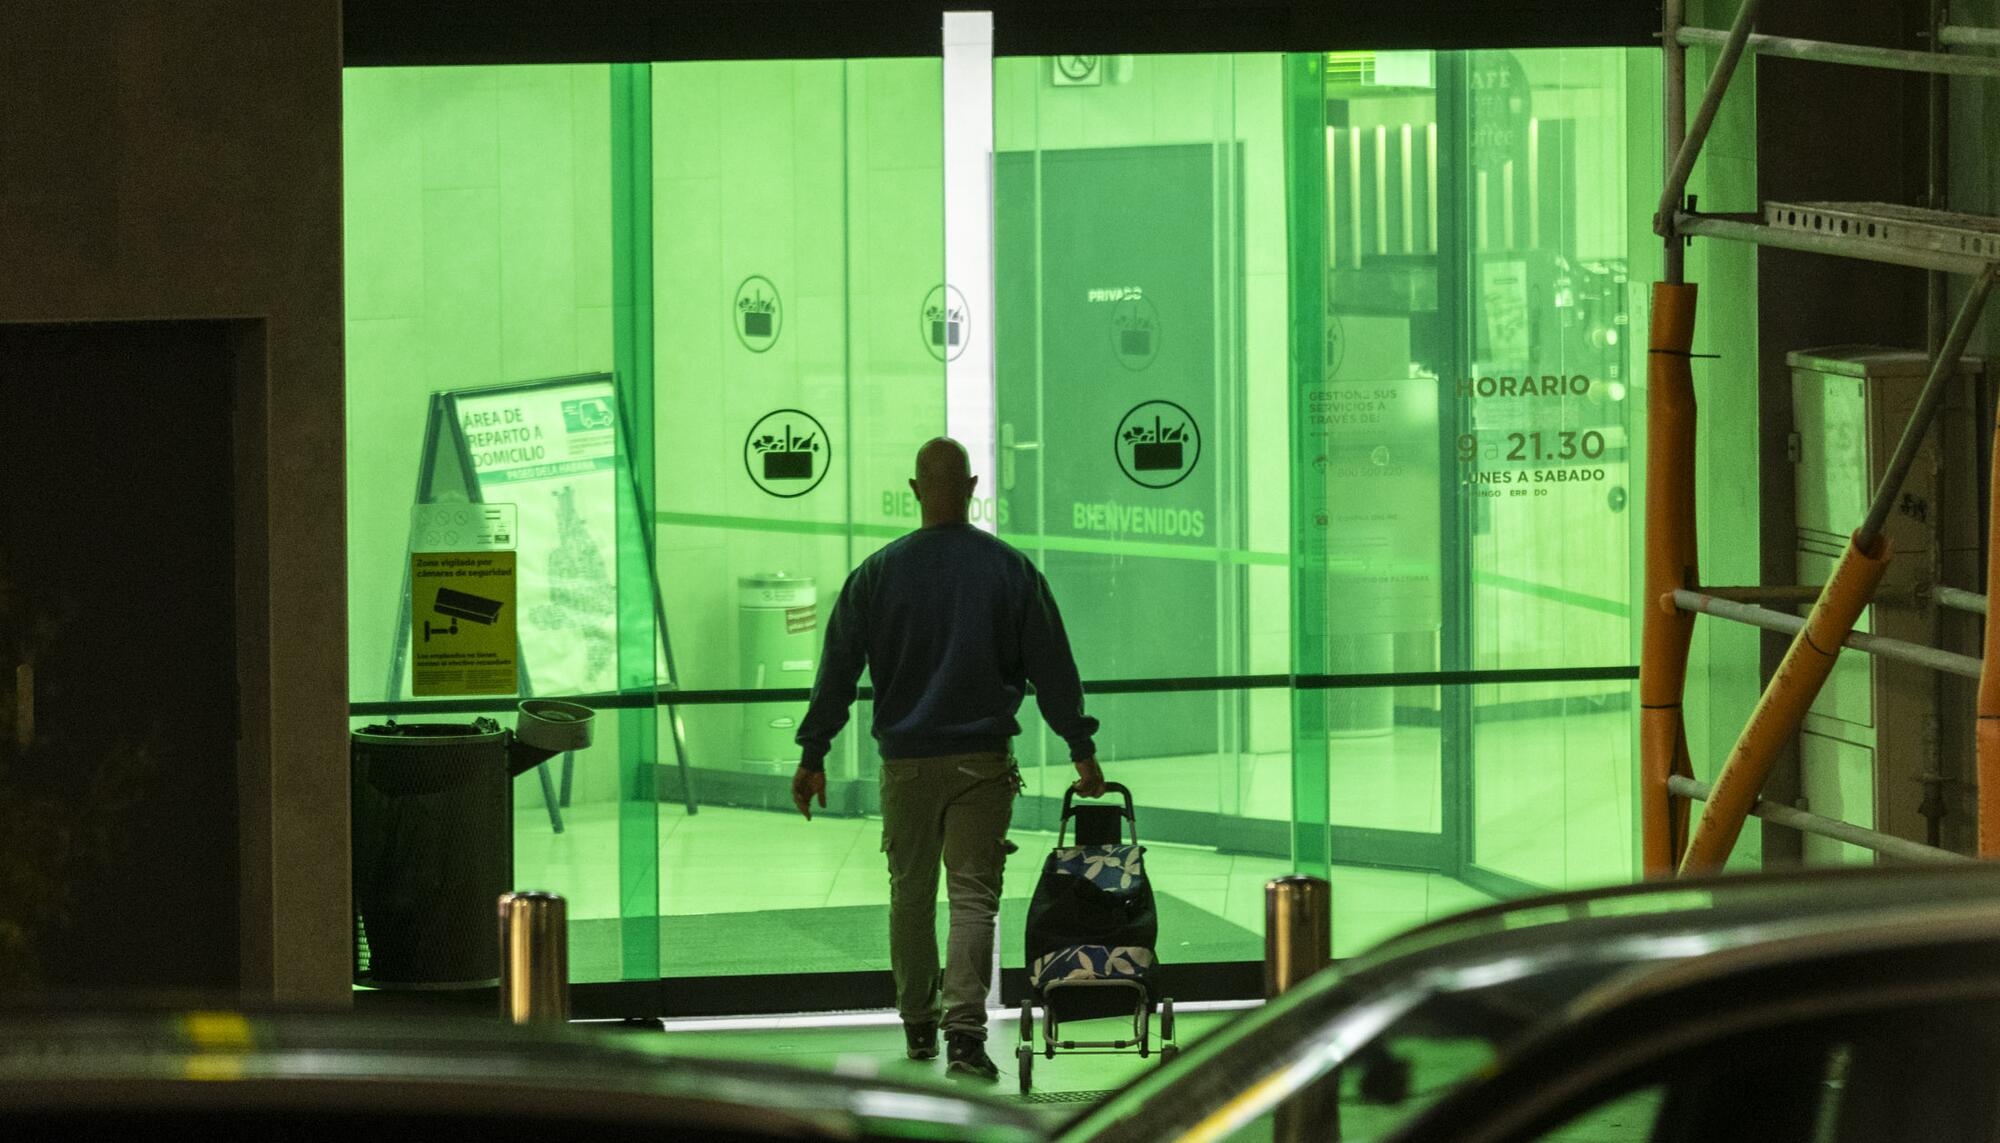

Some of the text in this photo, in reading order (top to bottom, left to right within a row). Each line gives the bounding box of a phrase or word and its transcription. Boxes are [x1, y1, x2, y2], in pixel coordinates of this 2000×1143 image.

[1087, 285, 1142, 302] PRIVADO
[1374, 389, 1397, 400] SUS
[1455, 374, 1590, 398] HORARIO
[1308, 401, 1387, 414] SERVICIOS A
[463, 408, 524, 430] ÁREA DE
[1360, 413, 1381, 424] DE:
[469, 425, 544, 448] REPARTO A
[1457, 433, 1478, 462] 9
[1506, 431, 1605, 462] 21.30
[472, 445, 545, 468] DOMICILIO
[1467, 469, 1605, 484] UNES A SABADO
[880, 490, 1010, 527] BIEDOS
[1073, 502, 1205, 538] BIENVENIDOS
[416, 558, 493, 569] Zona vigilada por
[416, 567, 513, 578] cámaras de seguridad
